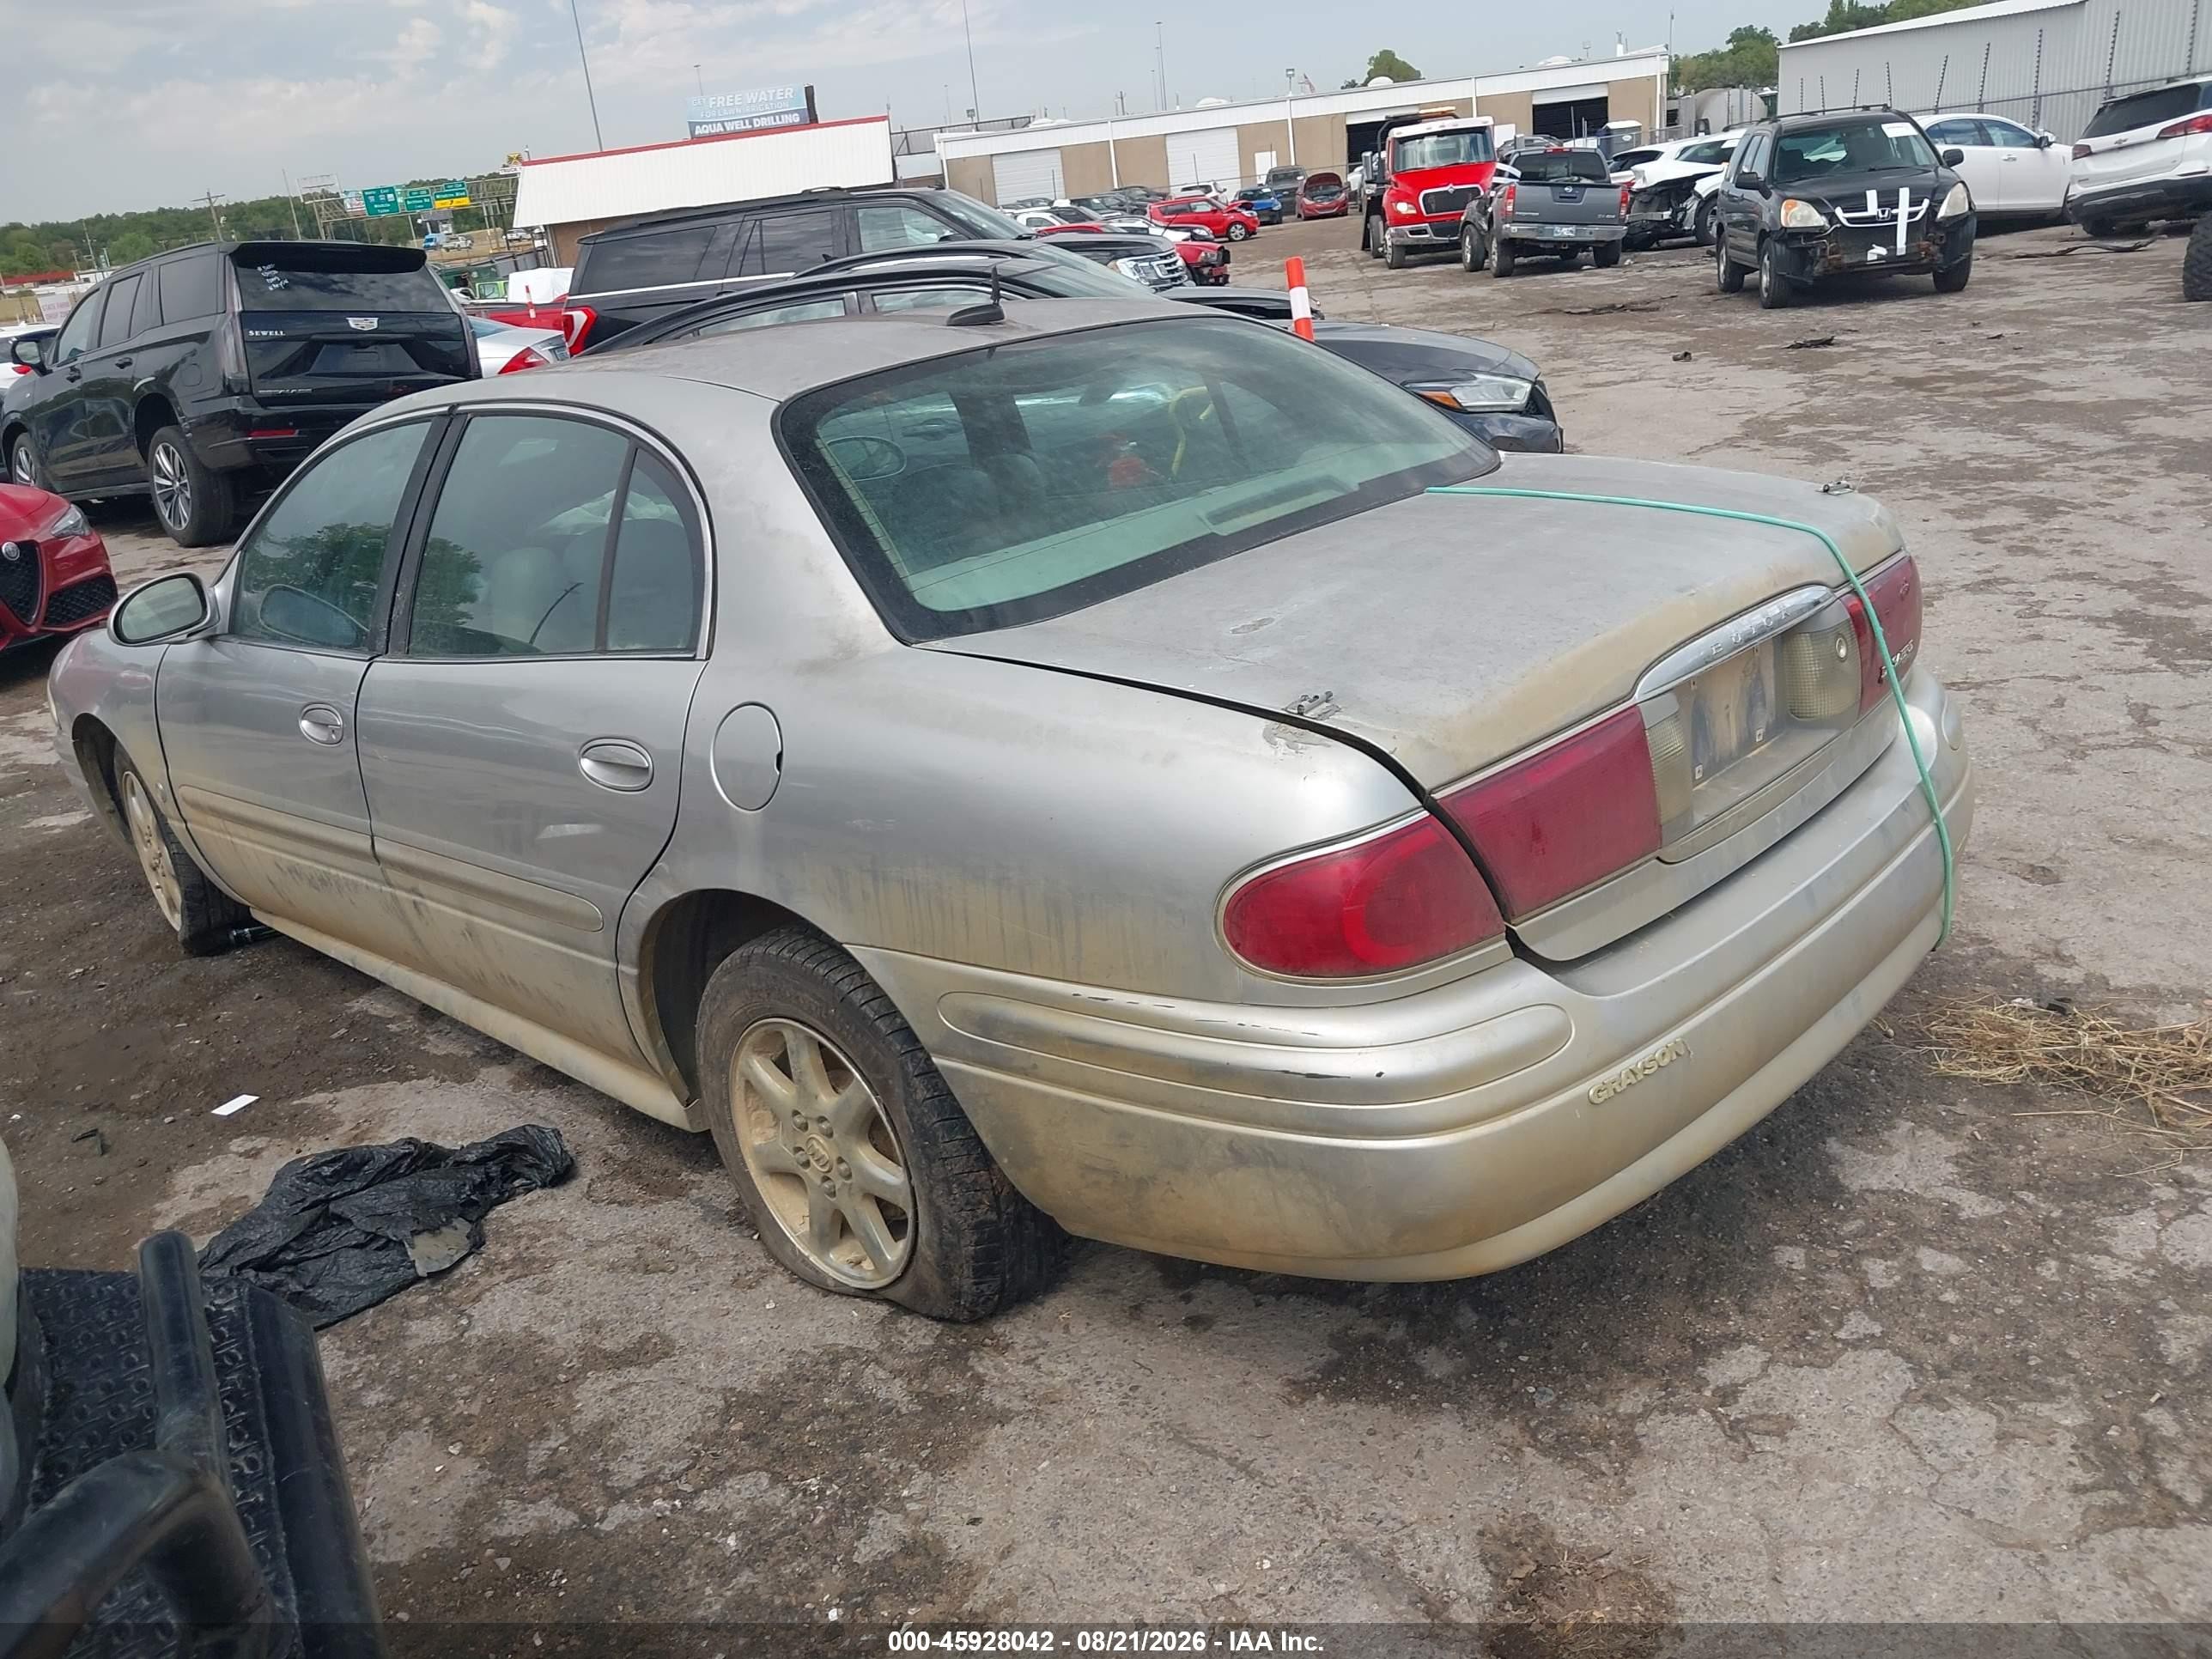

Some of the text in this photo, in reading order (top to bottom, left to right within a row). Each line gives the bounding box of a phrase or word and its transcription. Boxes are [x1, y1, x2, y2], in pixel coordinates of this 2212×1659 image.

[701, 101, 789, 118] FOR LAWN IRRIGATION
[709, 94, 743, 108] FREE
[746, 88, 794, 104] WATER
[695, 112, 800, 136] AQUA WELL DRILLING
[1710, 604, 1790, 656] BUICK
[1588, 1037, 1692, 1105] GRAYSON
